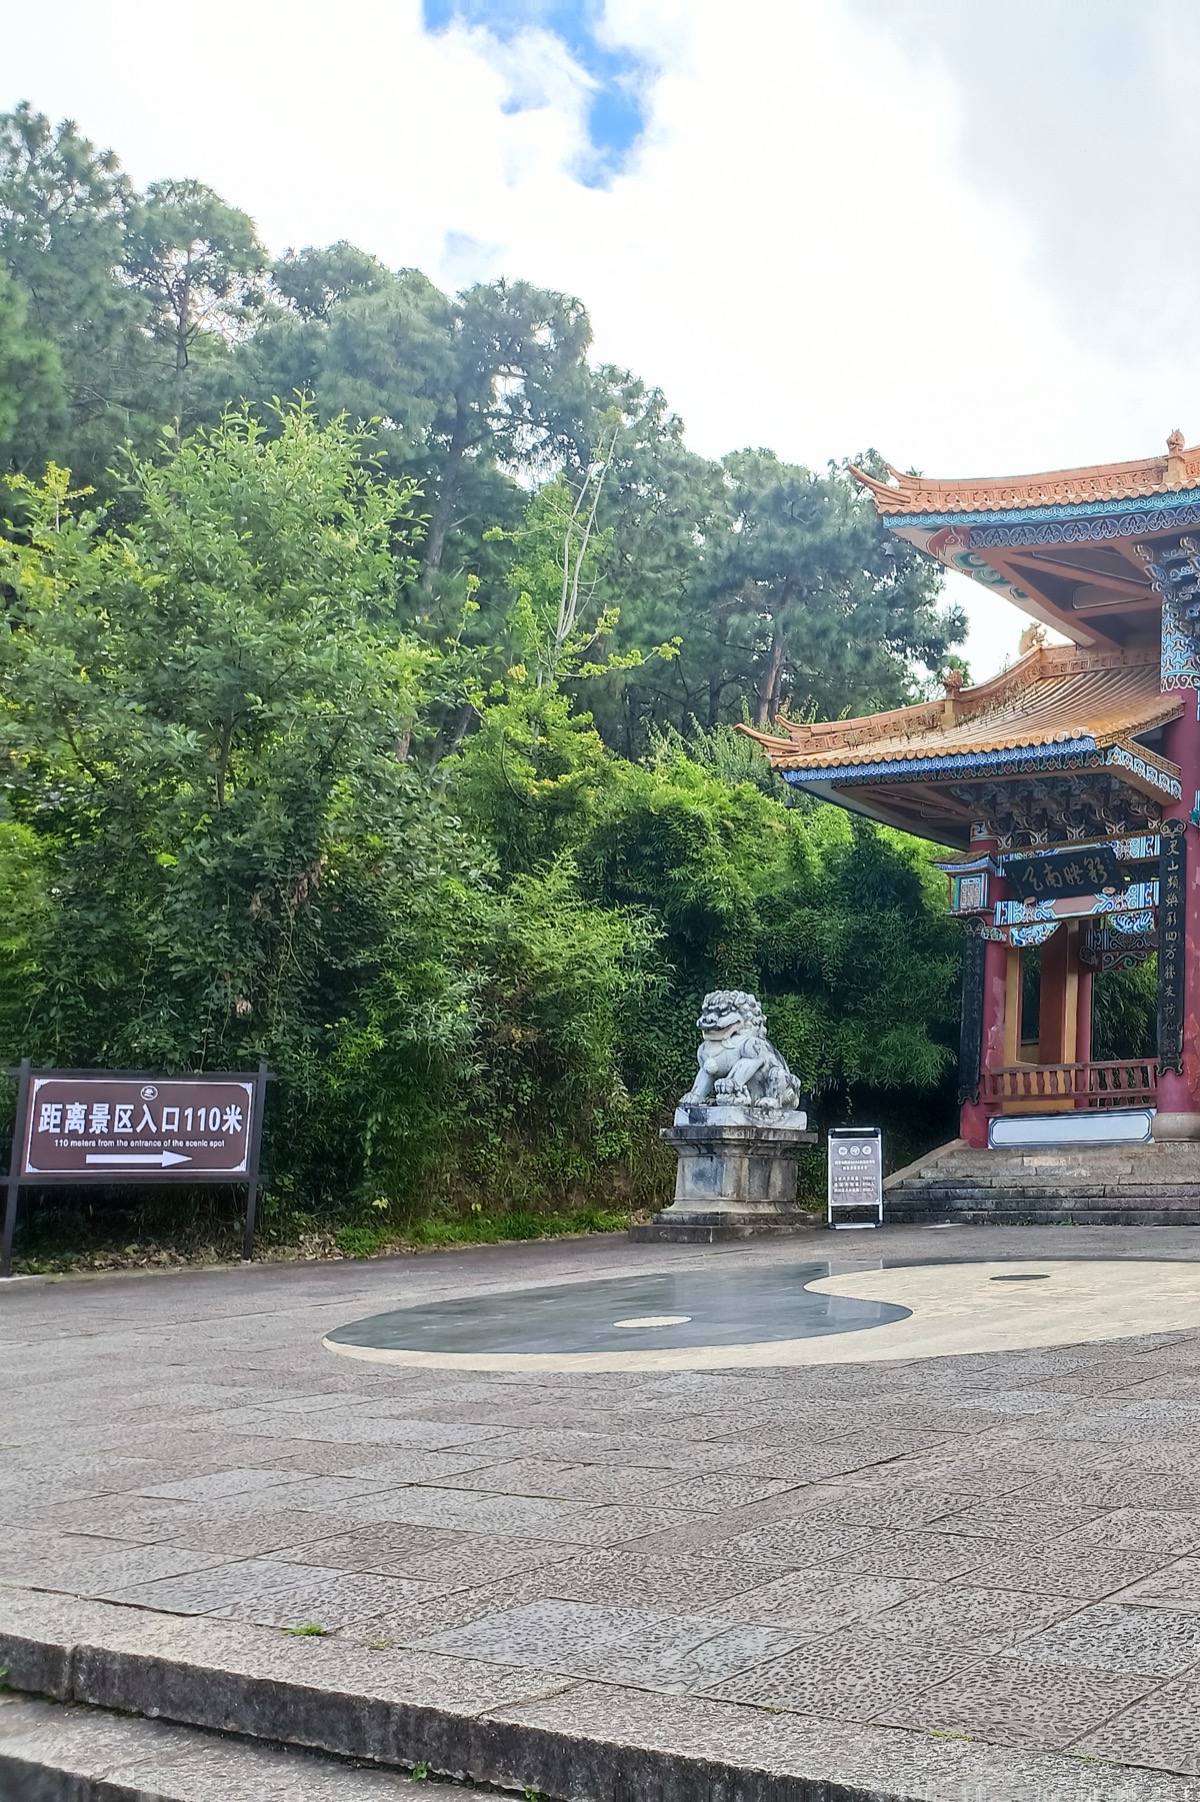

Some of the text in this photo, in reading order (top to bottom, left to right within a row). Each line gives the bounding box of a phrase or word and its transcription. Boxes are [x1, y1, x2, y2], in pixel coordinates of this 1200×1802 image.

[38, 1102, 243, 1134] 距离景区入口110米
[54, 1138, 225, 1149] 110 meters from the entrance of the scenic spot
